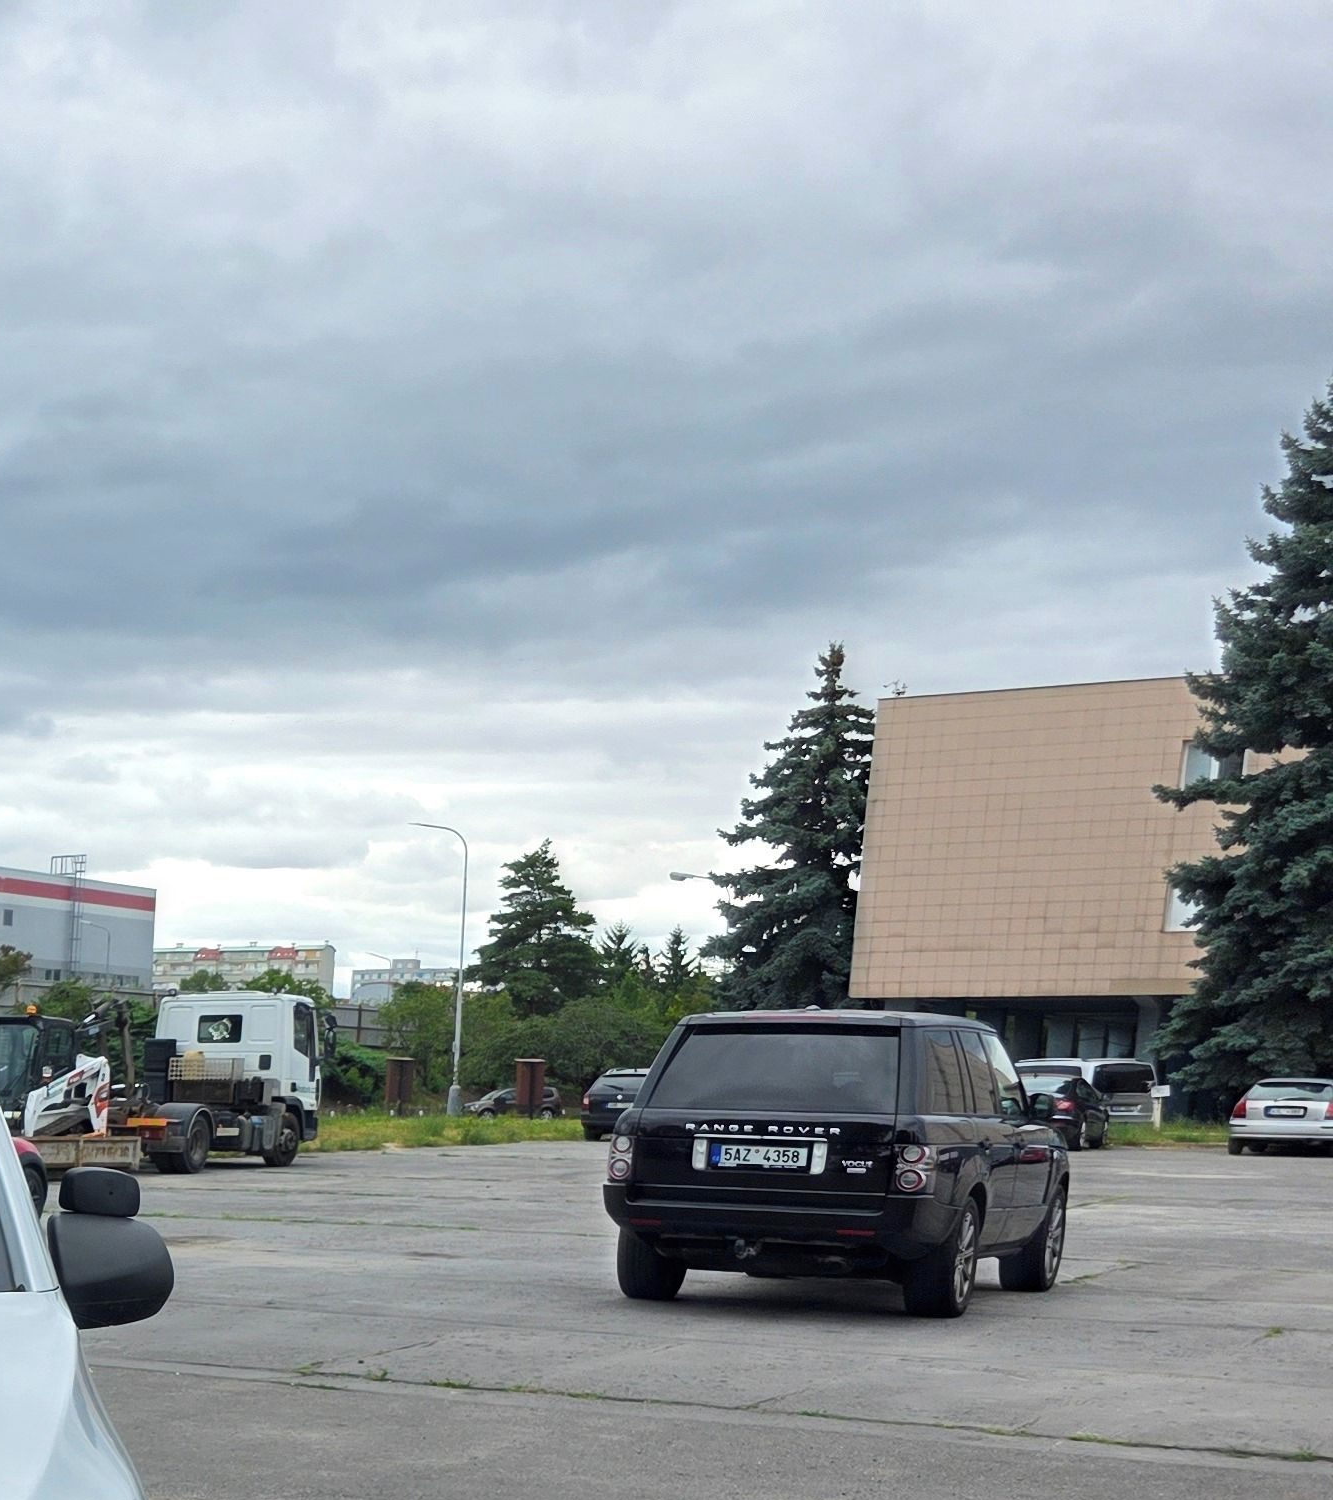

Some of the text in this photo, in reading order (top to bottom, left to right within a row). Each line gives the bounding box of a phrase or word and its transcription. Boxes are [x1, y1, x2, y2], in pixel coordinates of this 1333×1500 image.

[685, 1123, 841, 1135] RANGE ROVER
[724, 1147, 752, 1162] 5AZ
[762, 1149, 801, 1164] 4358
